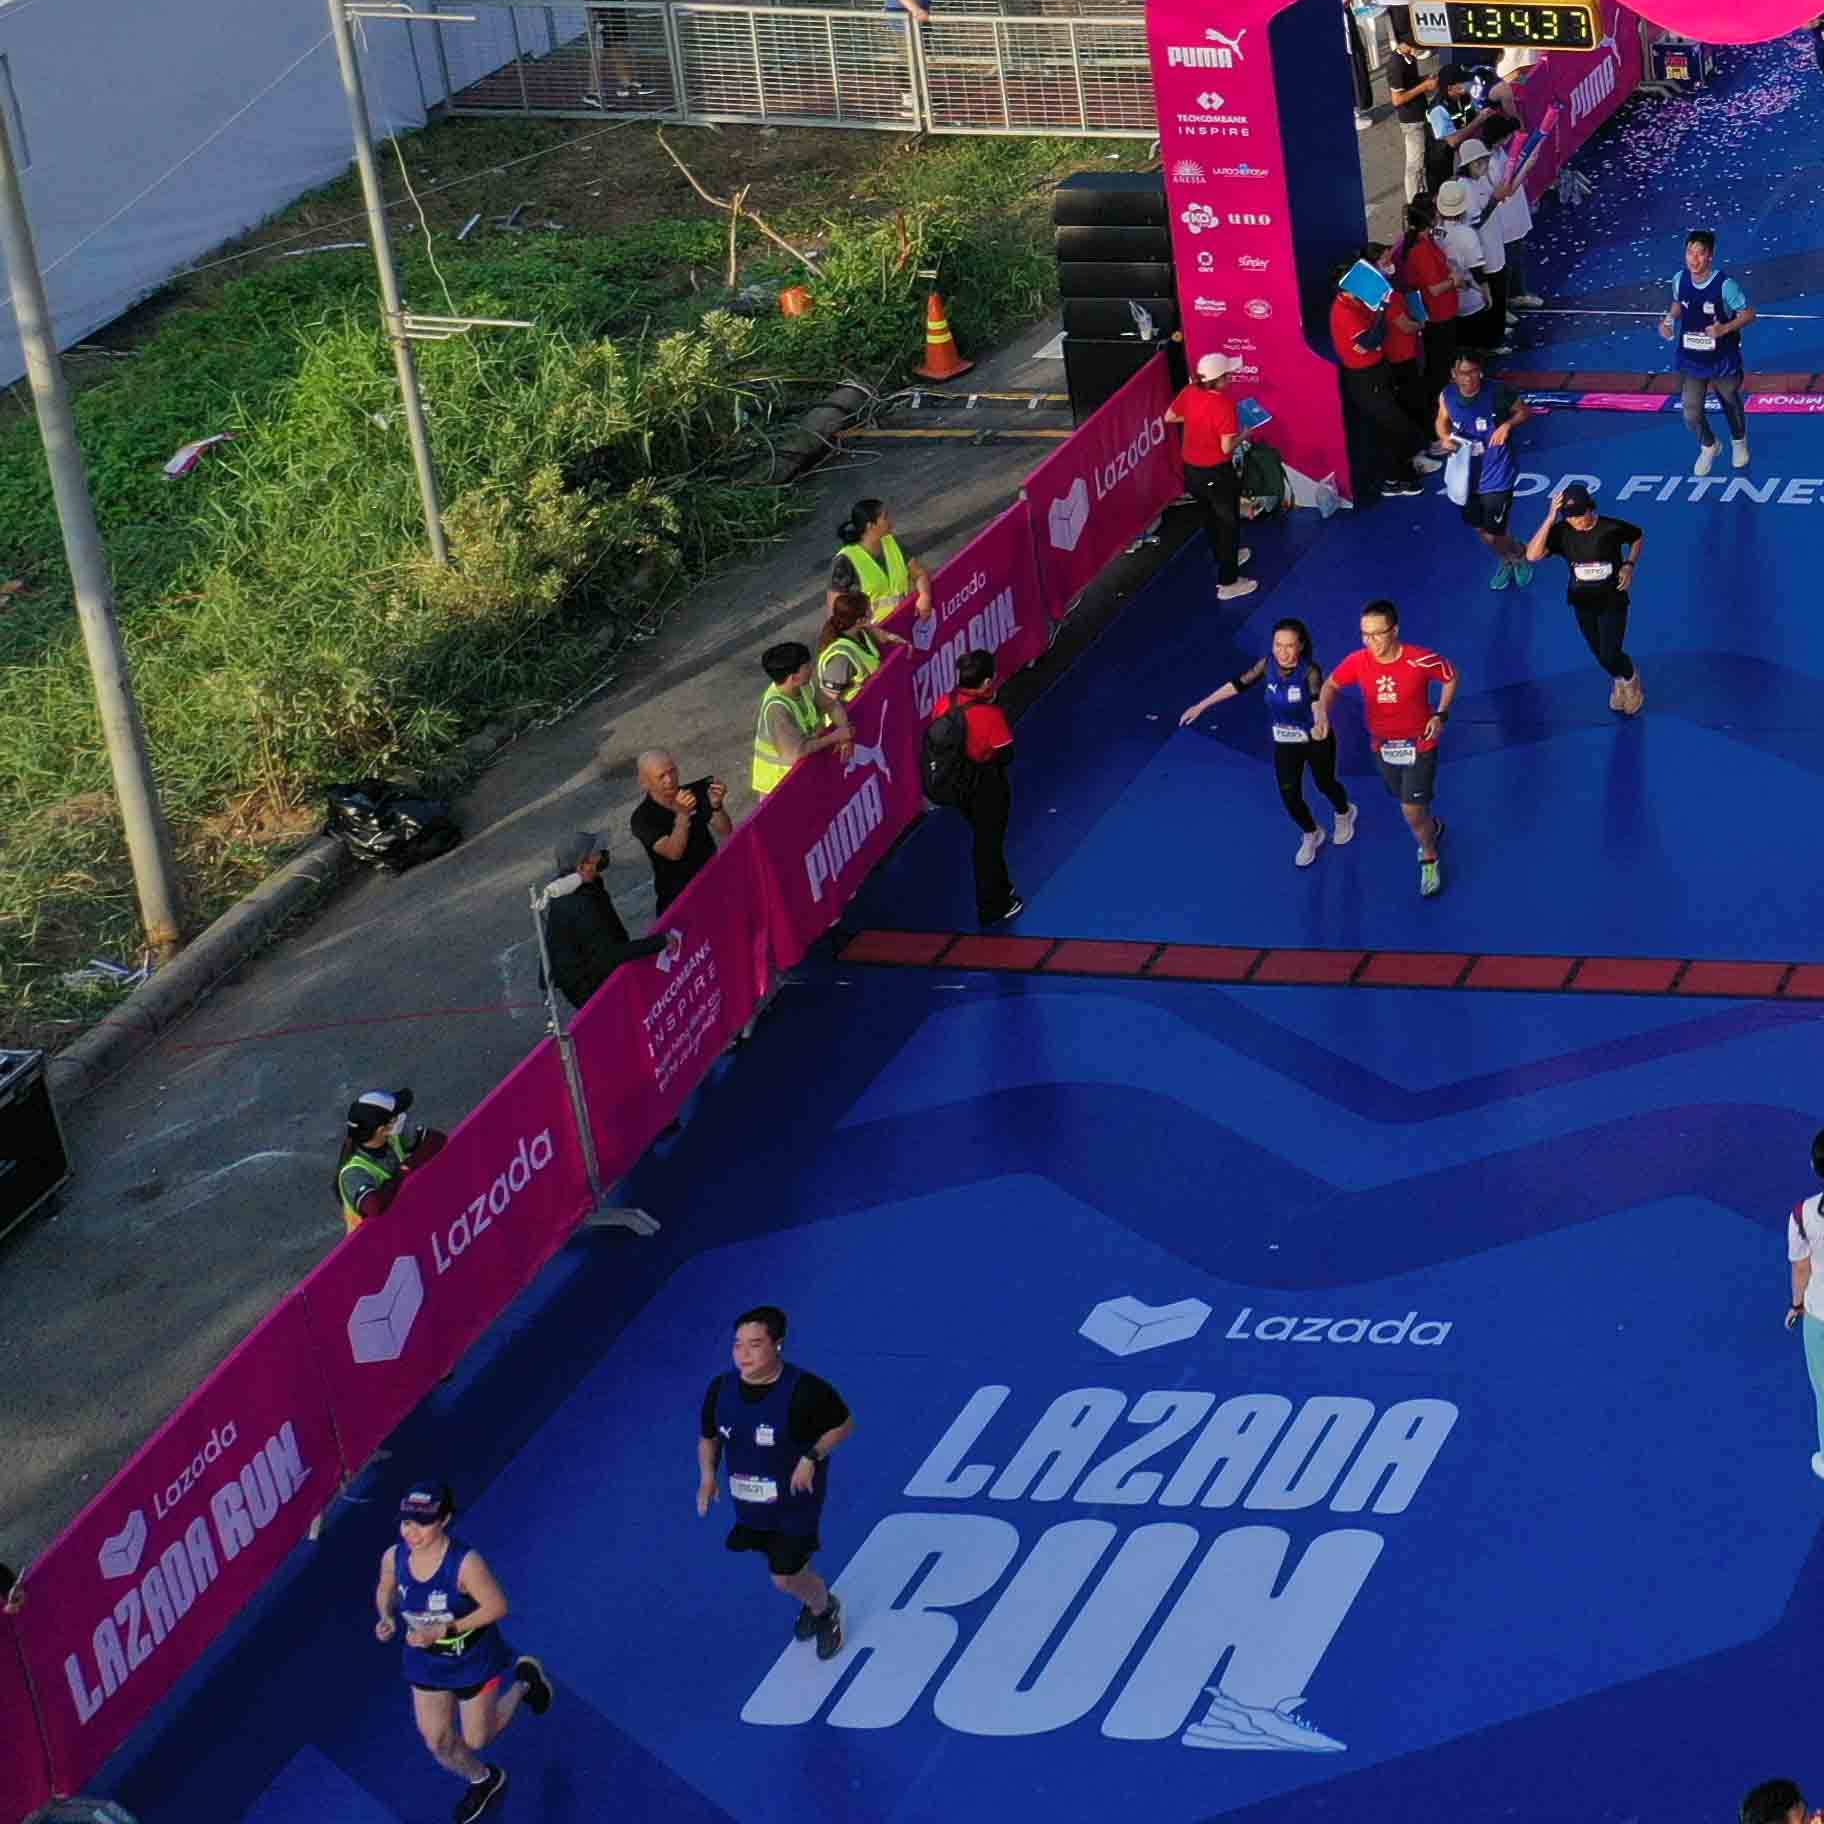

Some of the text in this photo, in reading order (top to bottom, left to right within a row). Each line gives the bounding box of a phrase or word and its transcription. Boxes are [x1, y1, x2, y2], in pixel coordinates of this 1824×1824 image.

[1168, 46, 1233, 69] PUMA
[1415, 12, 1447, 27] HM
[1570, 56, 1616, 128] PUMA
[1178, 127, 1250, 137] INSPIRE
[1228, 214, 1271, 226] uno
[1094, 415, 1165, 499] Lazada
[942, 571, 986, 622] Lazada
[803, 775, 885, 903] PUMA
[432, 1127, 556, 1275] Lazada
[1226, 1307, 1453, 1346] Lazada
[153, 1420, 239, 1519] Lazada
[903, 1384, 1459, 1514] LAZADA
[64, 1421, 311, 1726] LAZADA RUN
[741, 1512, 1384, 1752] RUN
